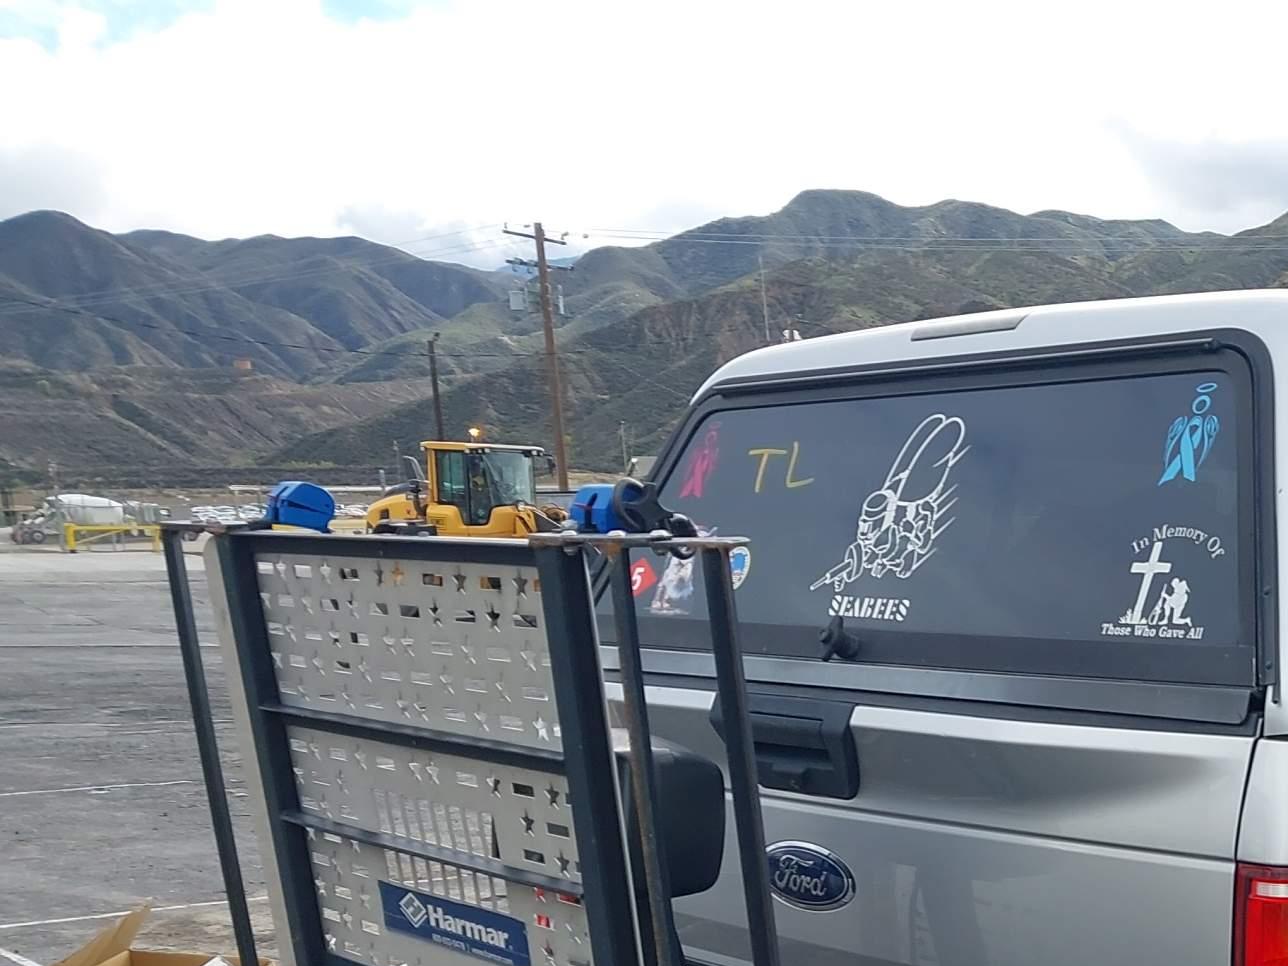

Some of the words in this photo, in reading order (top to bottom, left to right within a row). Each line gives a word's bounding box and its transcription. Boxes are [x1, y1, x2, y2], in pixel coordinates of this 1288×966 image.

[748, 441, 815, 493] TL
[1131, 537, 1150, 554] In
[1153, 524, 1208, 545] Memory
[1207, 536, 1225, 559] Of
[828, 594, 910, 622] SEABEES
[1101, 623, 1131, 636] Those
[1134, 625, 1156, 638] Who
[1158, 626, 1185, 639] Gave
[1186, 627, 1204, 640] All
[774, 854, 828, 897] Ford
[427, 904, 509, 950] Harmar
